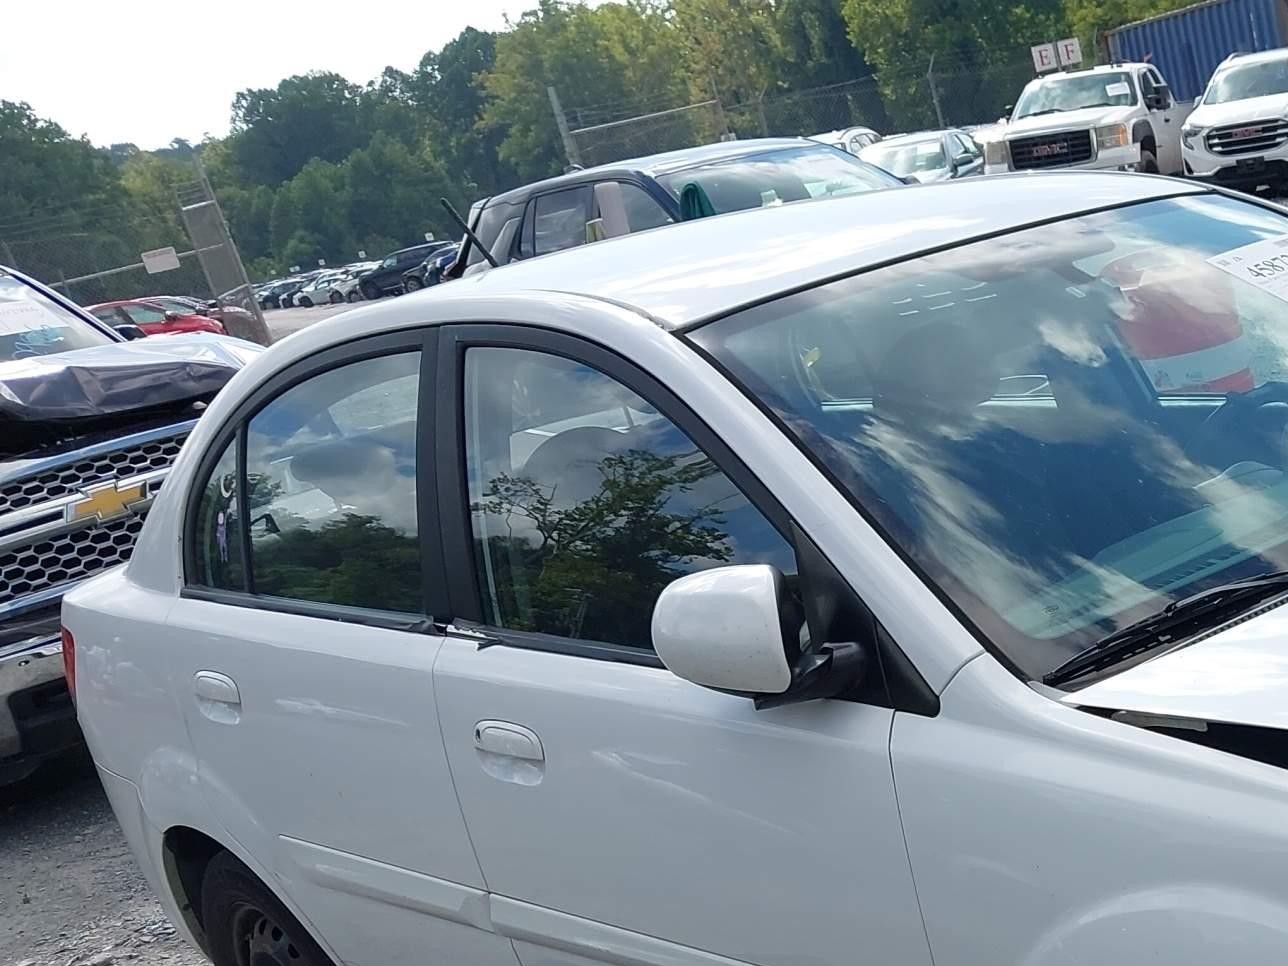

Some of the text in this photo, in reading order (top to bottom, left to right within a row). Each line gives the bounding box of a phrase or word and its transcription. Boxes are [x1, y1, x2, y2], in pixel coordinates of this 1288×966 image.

[1038, 48, 1051, 66] E
[1064, 43, 1074, 60] F
[1231, 127, 1264, 139] GMC
